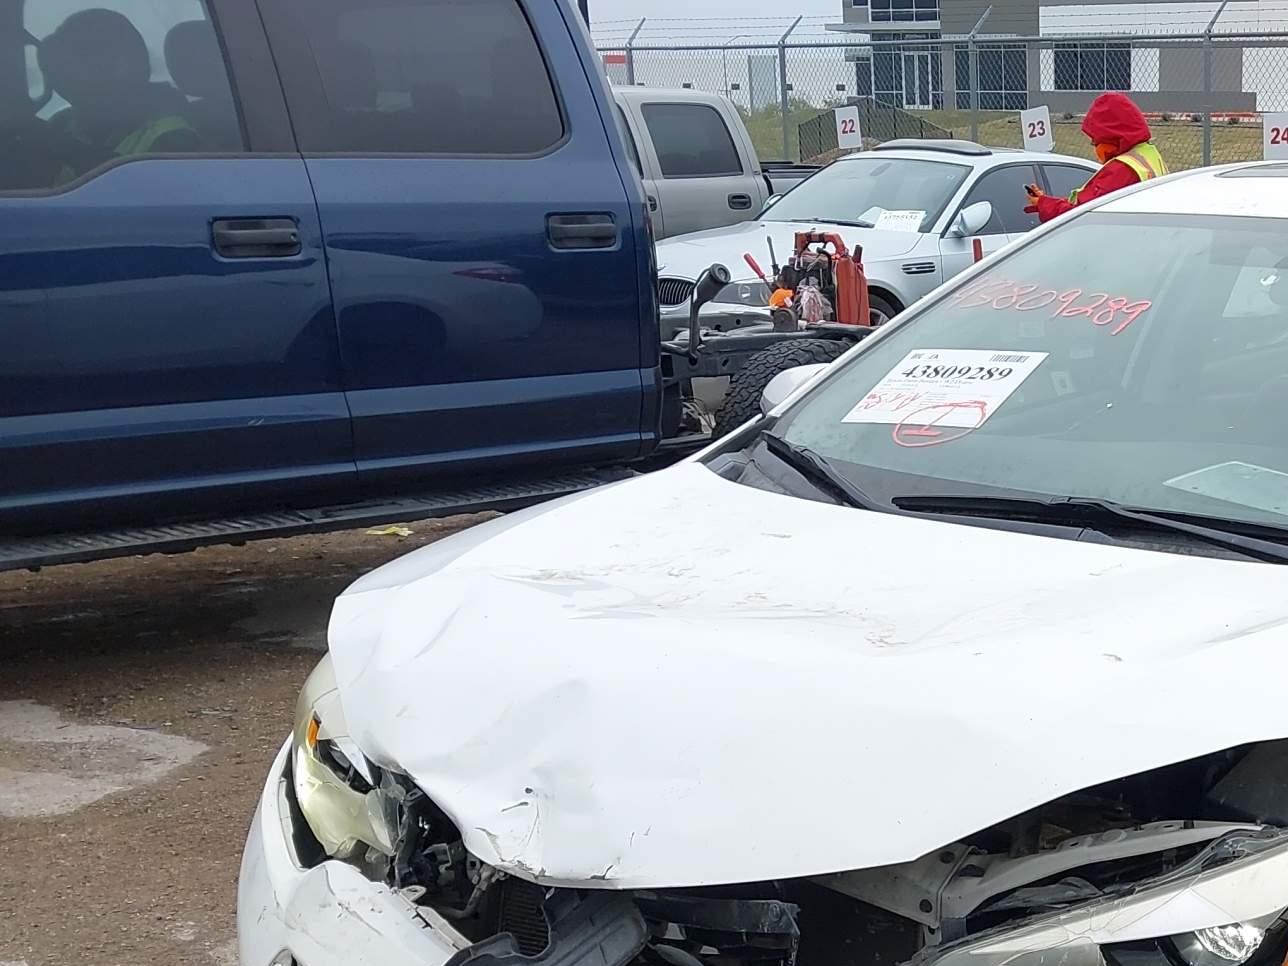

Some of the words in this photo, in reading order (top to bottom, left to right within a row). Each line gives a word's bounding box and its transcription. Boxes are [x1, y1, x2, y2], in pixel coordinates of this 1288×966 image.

[840, 118, 856, 135] 22
[1027, 121, 1047, 138] 23
[956, 278, 1152, 335] 43809289
[902, 365, 1013, 381] 43809289
